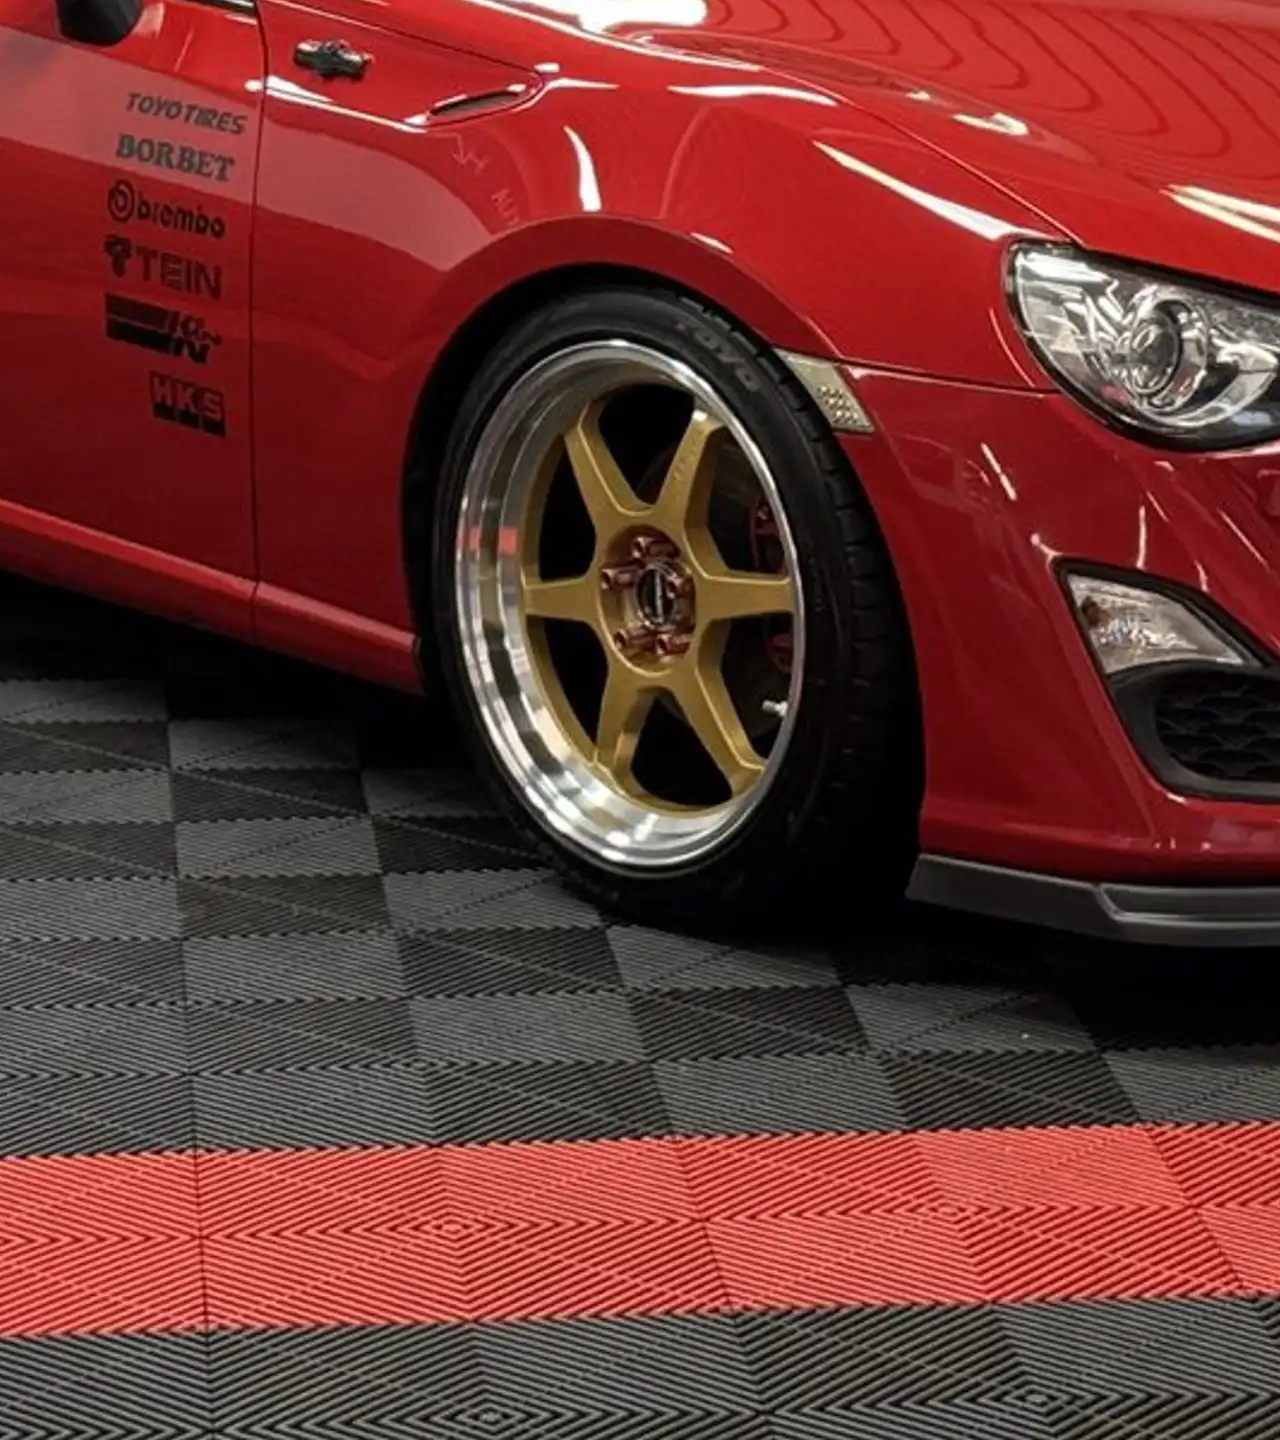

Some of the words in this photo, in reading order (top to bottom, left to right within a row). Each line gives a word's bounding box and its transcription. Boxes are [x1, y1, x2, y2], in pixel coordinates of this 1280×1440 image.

[116, 133, 235, 182] BORBET
[137, 191, 225, 239] brembo
[135, 243, 221, 300] TEIN
[150, 374, 223, 422] HKS
